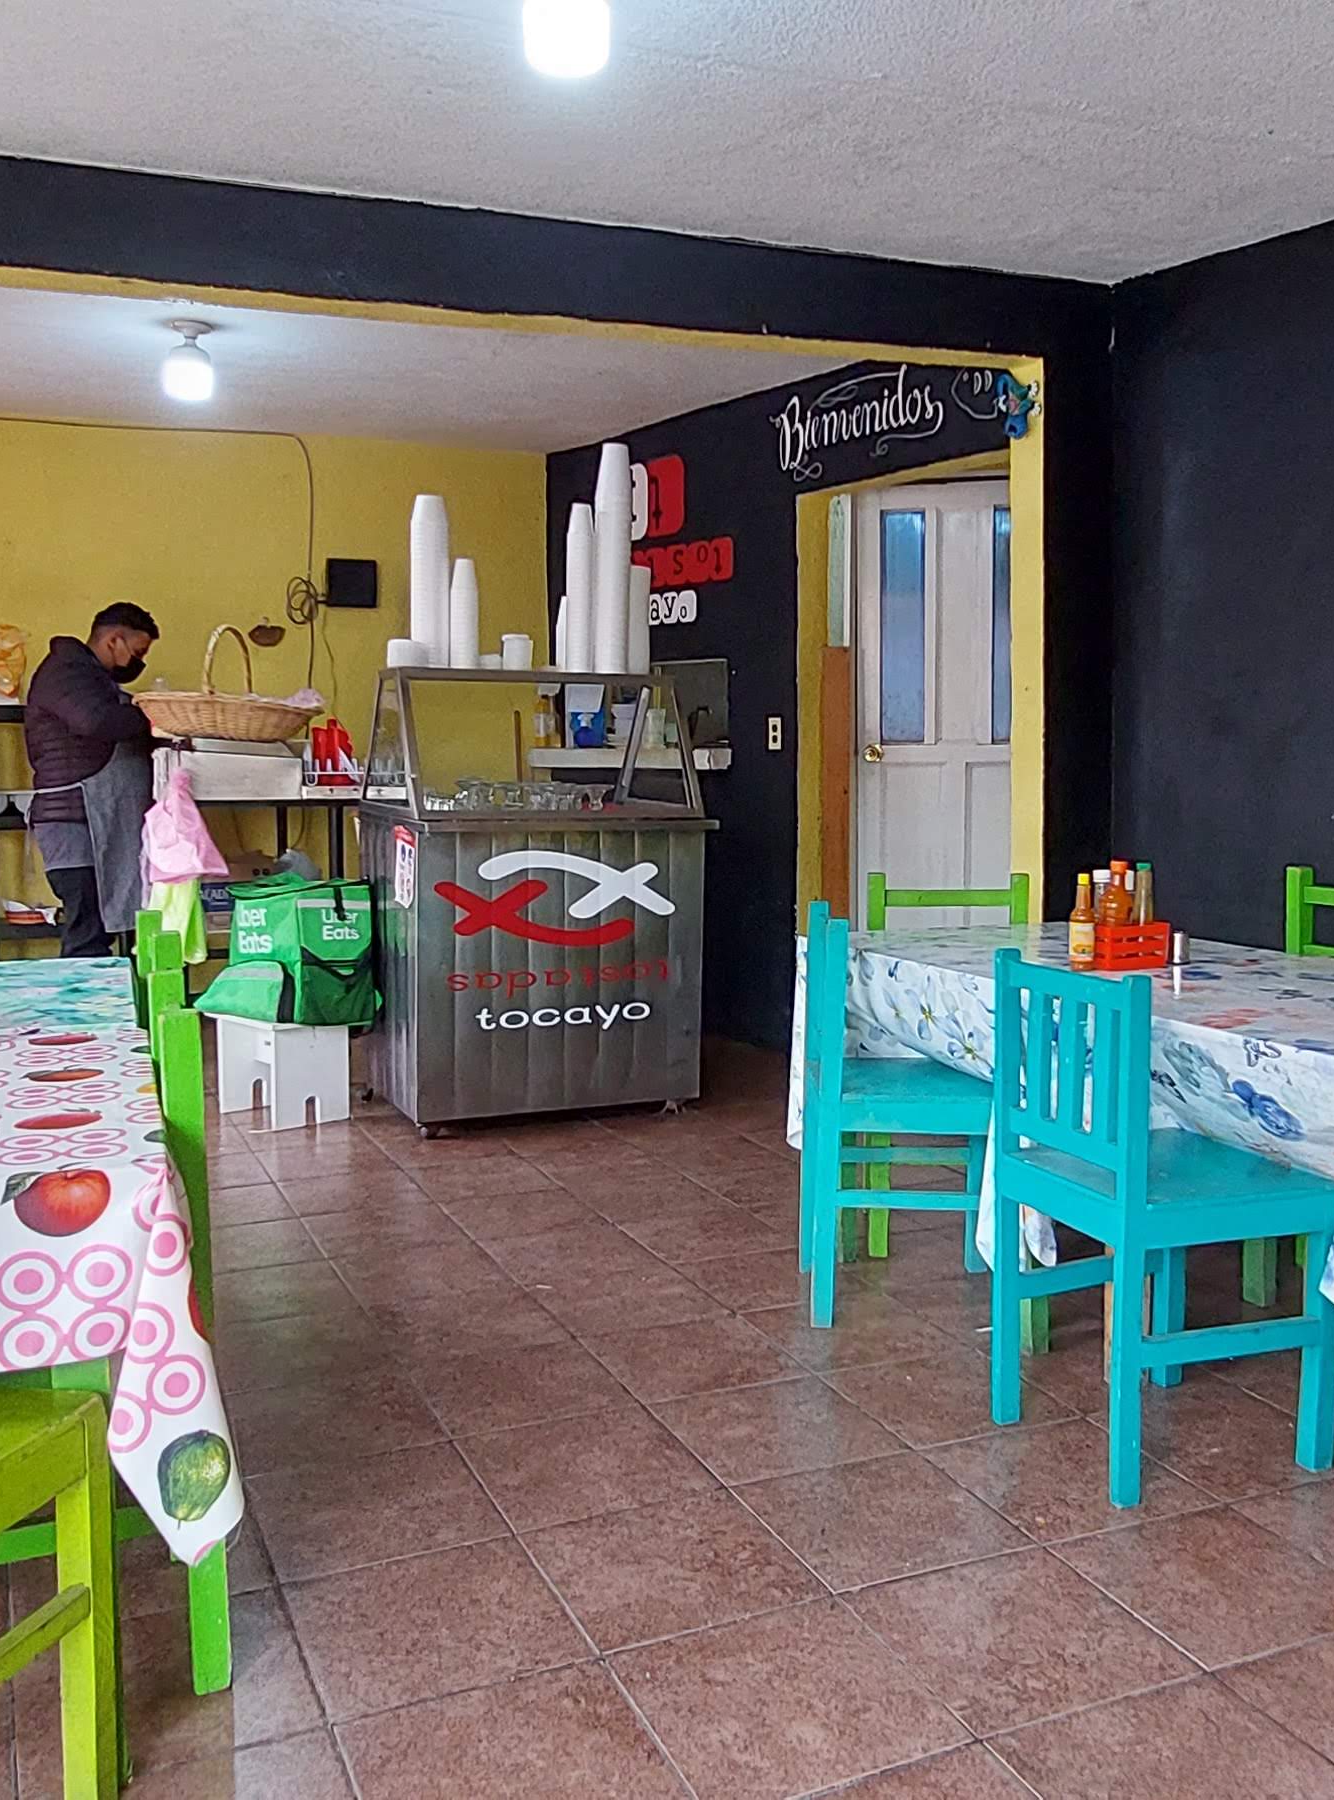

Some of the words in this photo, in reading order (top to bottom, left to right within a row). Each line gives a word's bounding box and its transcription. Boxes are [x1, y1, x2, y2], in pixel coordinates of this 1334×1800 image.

[770, 364, 943, 472] Bienvenidos
[238, 930, 274, 954] Eats
[322, 925, 360, 941] Eats
[447, 959, 670, 998] tostadas
[475, 1000, 651, 1031] tocayo
